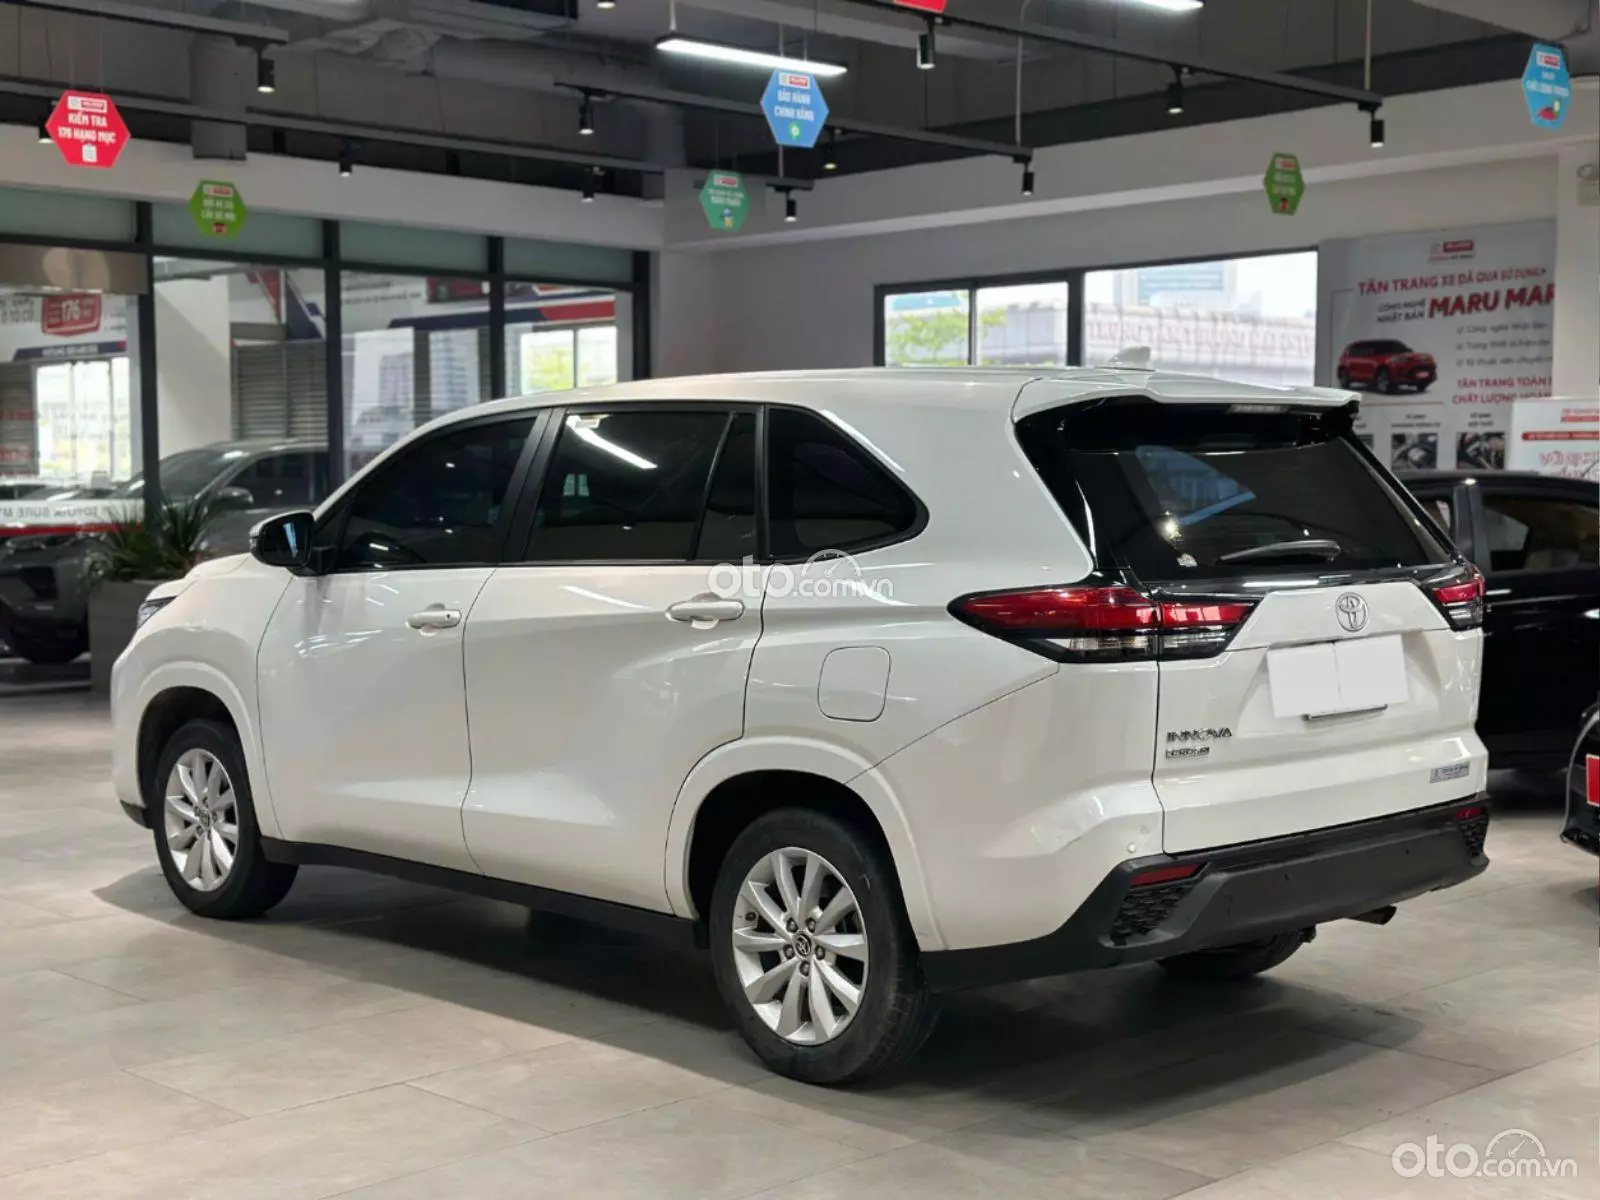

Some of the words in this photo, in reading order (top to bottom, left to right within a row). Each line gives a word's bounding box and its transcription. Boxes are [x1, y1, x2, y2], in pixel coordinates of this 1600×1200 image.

[91, 115, 108, 128] TRA
[1358, 279, 1389, 297] TÂN
[1392, 274, 1439, 294] TRANG
[1441, 274, 1456, 287] XE
[1476, 270, 1498, 285] QUA
[1428, 291, 1500, 319] MARU
[1480, 376, 1514, 388] TRANG
[1167, 727, 1232, 742] INNOVA
